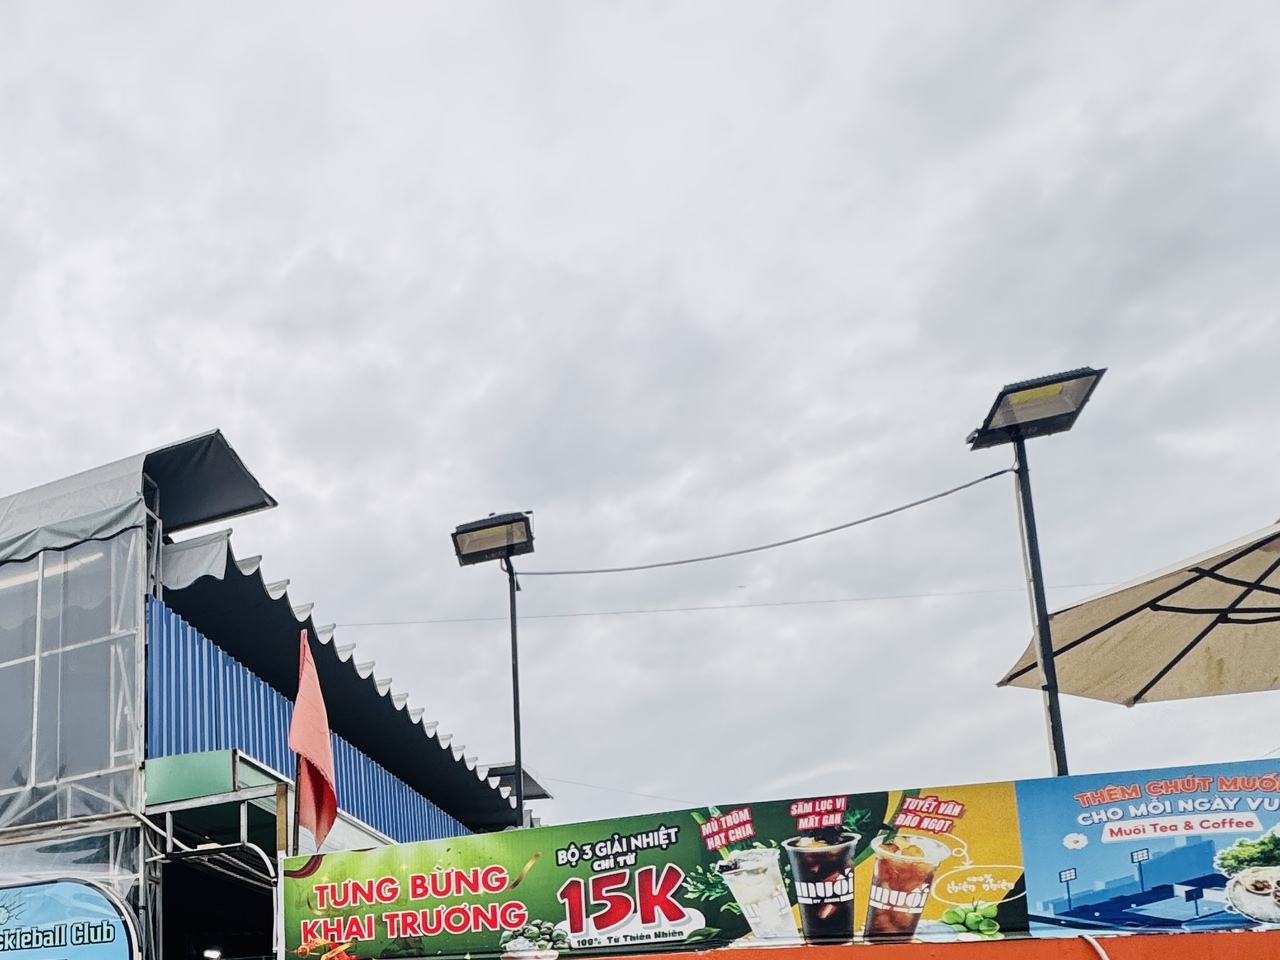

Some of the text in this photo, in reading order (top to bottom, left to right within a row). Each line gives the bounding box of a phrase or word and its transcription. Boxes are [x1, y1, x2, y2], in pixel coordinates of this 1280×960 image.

[1074, 784, 1141, 807] THÊM
[1145, 775, 1213, 797] CHÚT
[1077, 807, 1124, 826] CHO
[1128, 796, 1172, 818] MỖI
[1178, 794, 1241, 813] NGÀY
[1150, 822, 1178, 833] Tea
[1184, 820, 1194, 831] &
[1199, 817, 1255, 830] Coffee
[557, 825, 679, 866] BỘ 3 GIẢI NHIỆT
[409, 864, 509, 901] BỪNG
[557, 862, 687, 934] 15K
[72, 920, 115, 945] Club
[301, 901, 529, 944] KHAI TRƯƠNG
